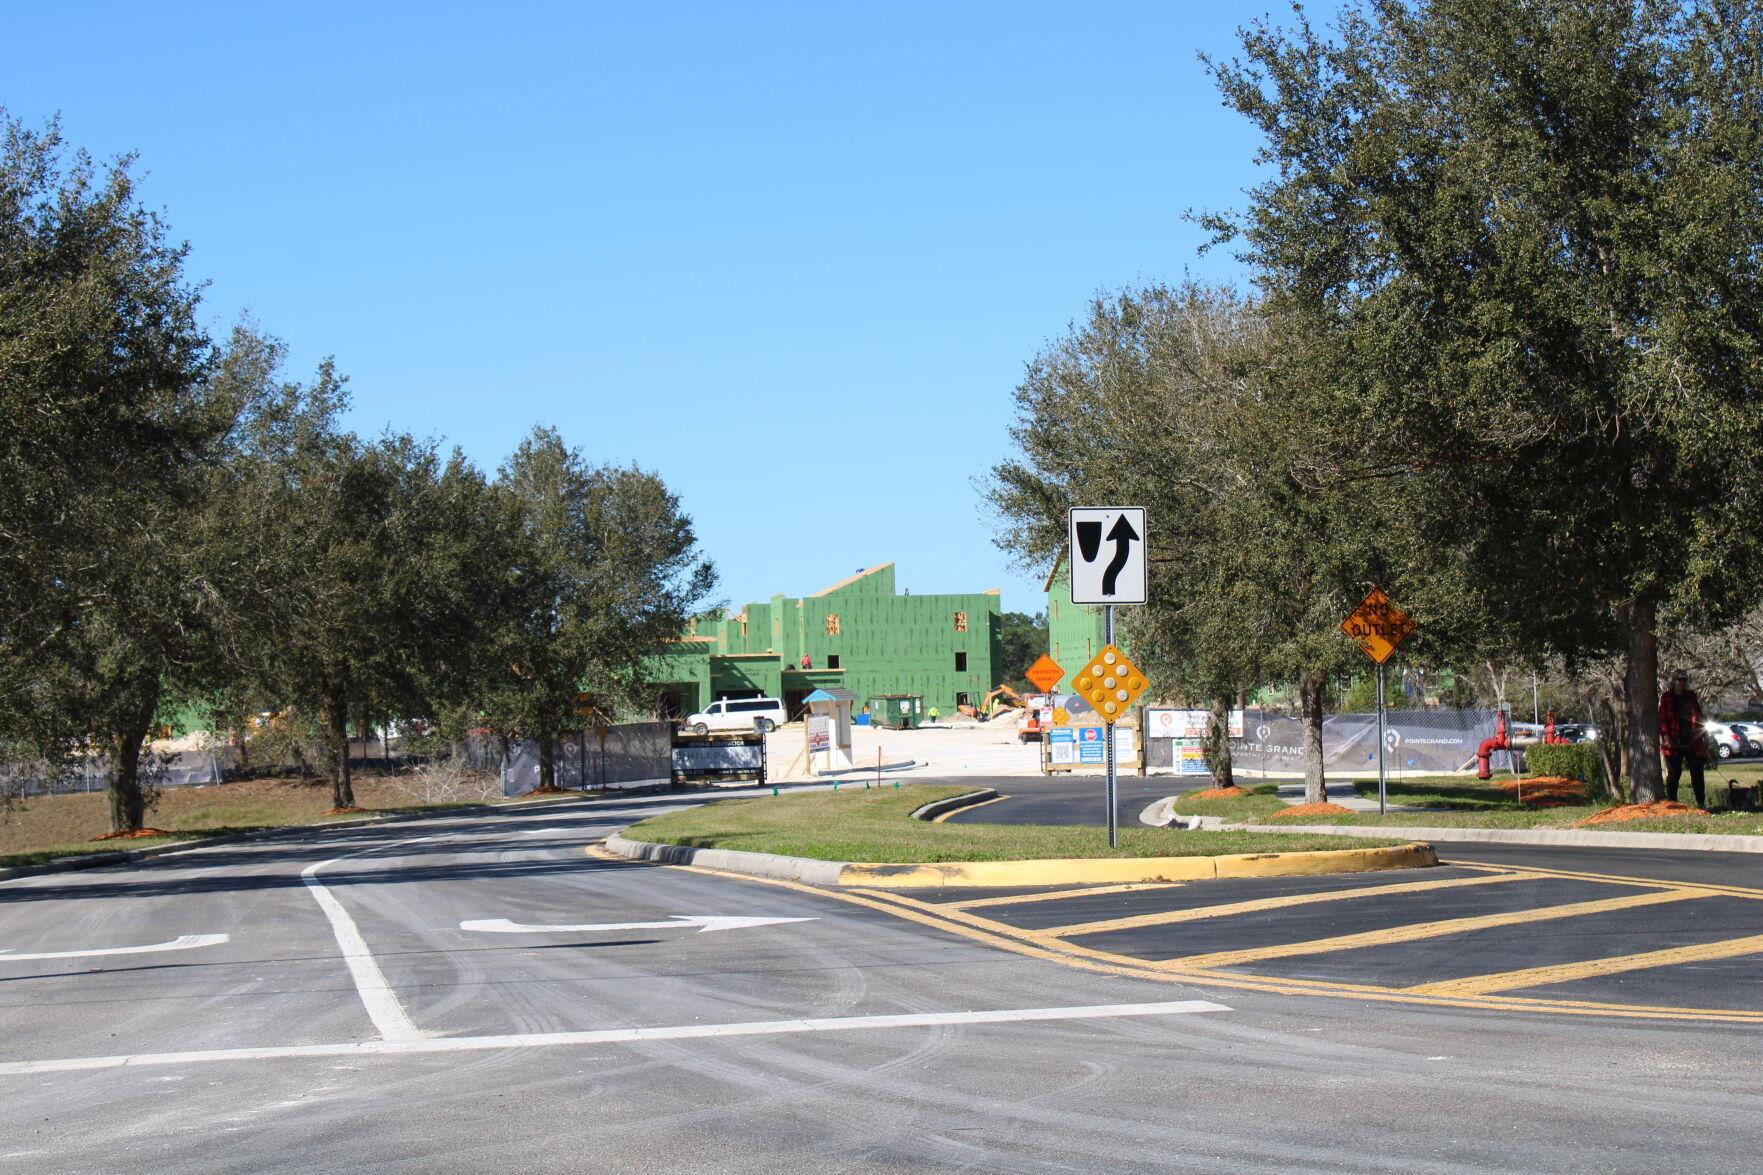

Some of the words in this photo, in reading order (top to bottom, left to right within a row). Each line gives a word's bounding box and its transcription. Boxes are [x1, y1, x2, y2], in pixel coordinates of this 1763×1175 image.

[1368, 603, 1389, 617] NO
[1352, 623, 1406, 636] OUTLET
[1229, 740, 1262, 752] OINTE
